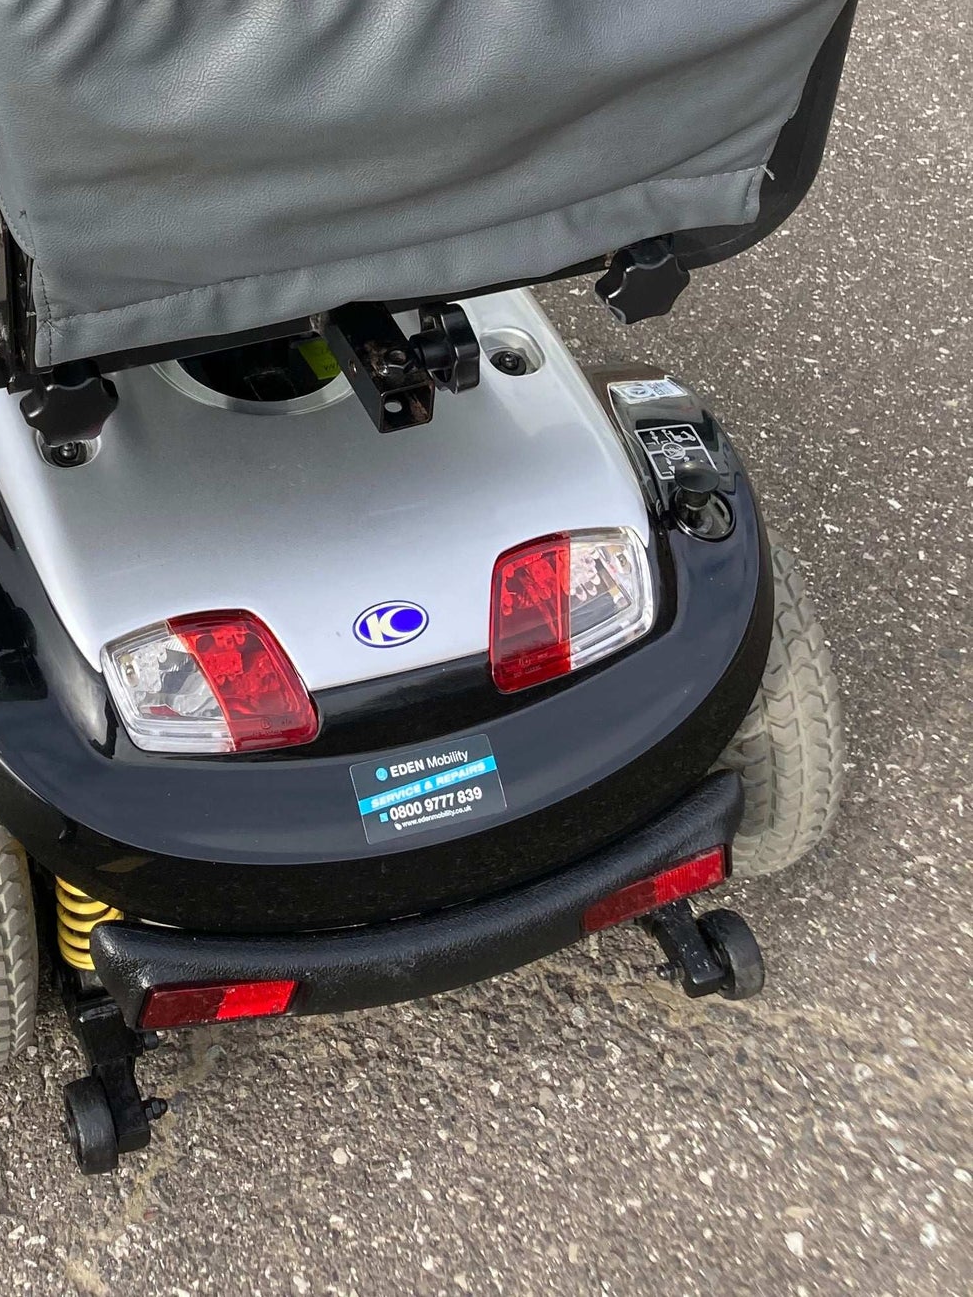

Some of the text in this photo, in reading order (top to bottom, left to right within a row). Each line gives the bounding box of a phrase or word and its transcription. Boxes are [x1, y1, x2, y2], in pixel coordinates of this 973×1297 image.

[389, 750, 469, 778] EDEN Mobility
[370, 761, 487, 809] SERVICE & REPAIRS
[389, 786, 483, 821] 0800 9777 839
